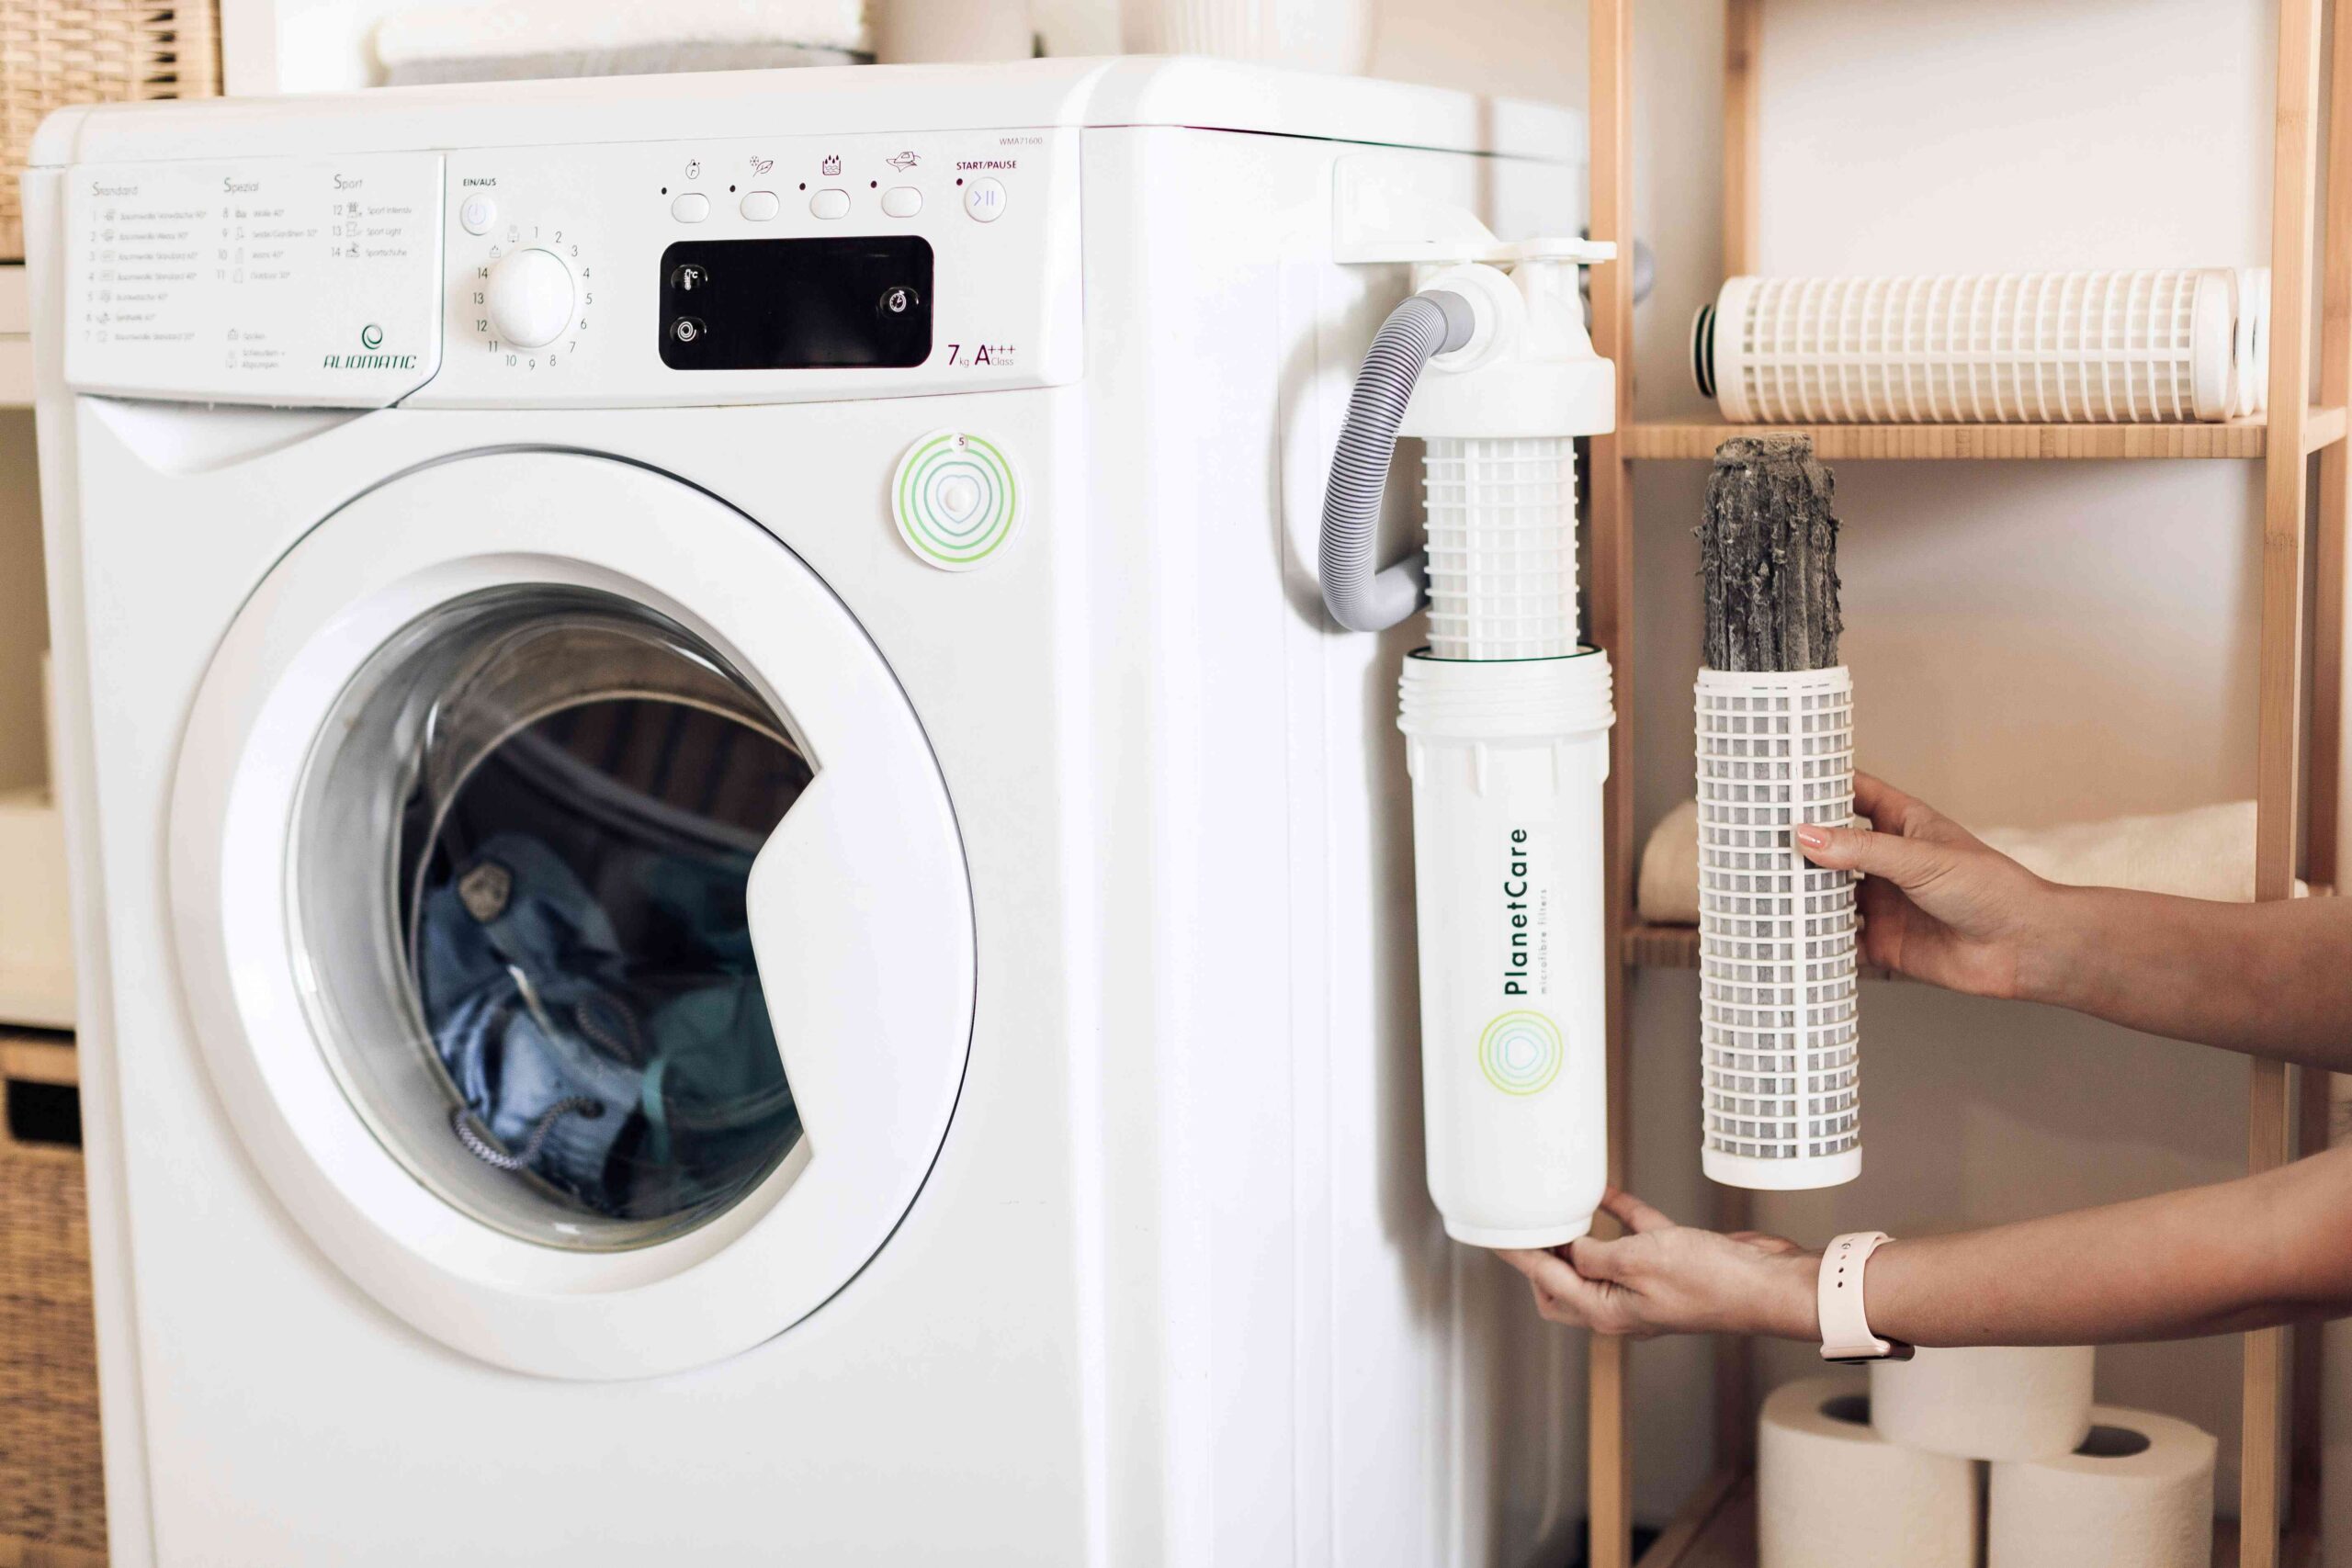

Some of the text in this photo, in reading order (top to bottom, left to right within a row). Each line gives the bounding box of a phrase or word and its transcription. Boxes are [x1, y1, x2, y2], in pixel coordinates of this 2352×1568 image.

[999, 137, 1043, 146] WMA71600
[956, 160, 1017, 170] START/PAUSE
[334, 174, 364, 192] Sport
[463, 178, 497, 186] EIN/AUS
[333, 204, 343, 216] 12
[332, 225, 342, 236] 13
[533, 226, 539, 239] 1
[555, 231, 562, 243] 2
[331, 247, 341, 258] 14
[571, 245, 578, 257] 3
[477, 266, 489, 279] 14
[582, 266, 591, 279] 4
[472, 292, 484, 305] 13
[585, 292, 593, 305] 5
[476, 320, 488, 332] 12
[580, 317, 587, 330] 6
[488, 341, 498, 353] 11
[570, 341, 576, 353] 7
[505, 355, 517, 367] 10
[549, 355, 556, 367] 8
[948, 344, 970, 367] 7 kg
[990, 355, 1014, 367] Class
[322, 354, 417, 370] ALIOMATIC
[528, 358, 536, 370] 9
[958, 436, 965, 446] 5
[1504, 829, 1527, 995] PlanetCare
